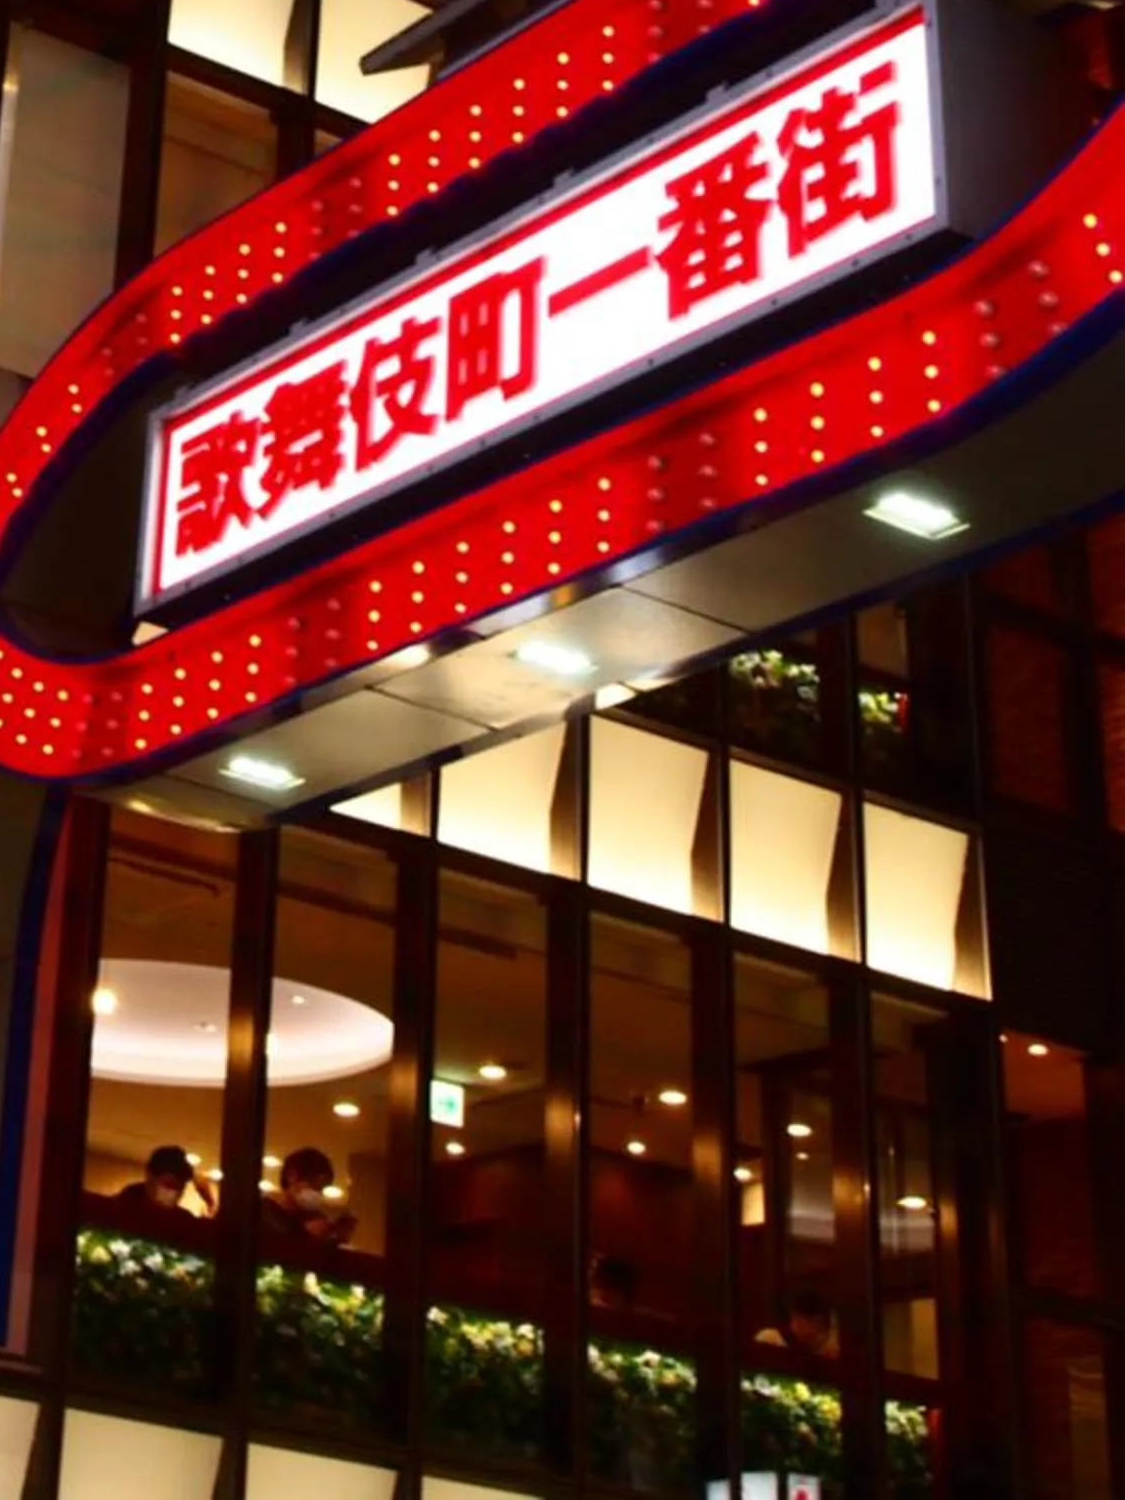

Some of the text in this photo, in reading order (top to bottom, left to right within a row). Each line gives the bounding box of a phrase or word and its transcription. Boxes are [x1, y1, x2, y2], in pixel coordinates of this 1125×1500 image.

[175, 60, 902, 557] 歌舞伎町一番街
